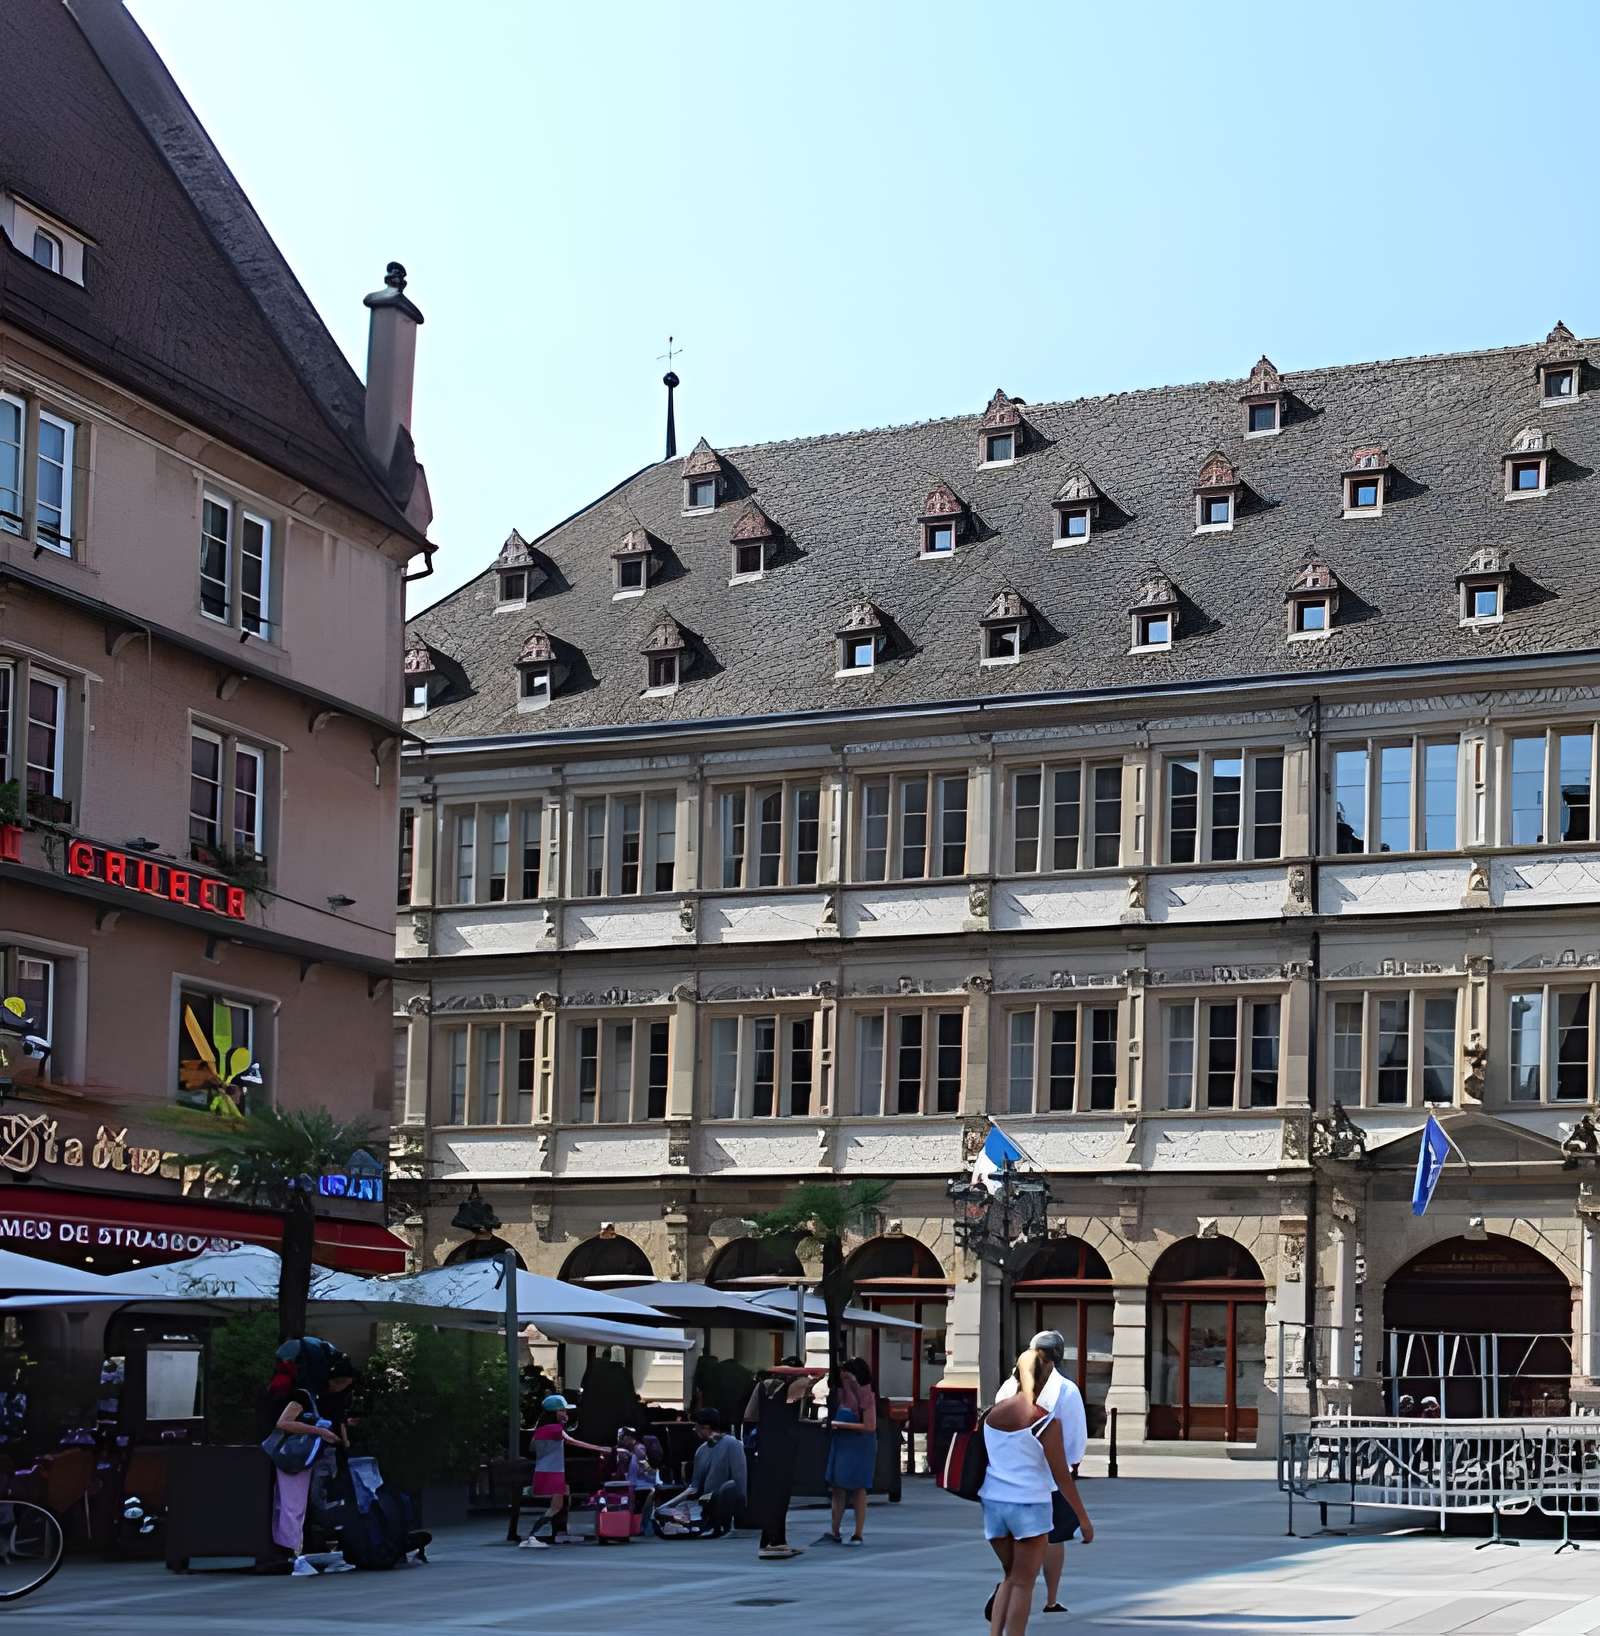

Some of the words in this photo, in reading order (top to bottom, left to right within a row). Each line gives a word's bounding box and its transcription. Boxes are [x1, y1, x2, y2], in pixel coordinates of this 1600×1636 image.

[69, 839, 246, 920] GRUBER
[0, 1218, 51, 1240] MES
[59, 1223, 89, 1244] DE
